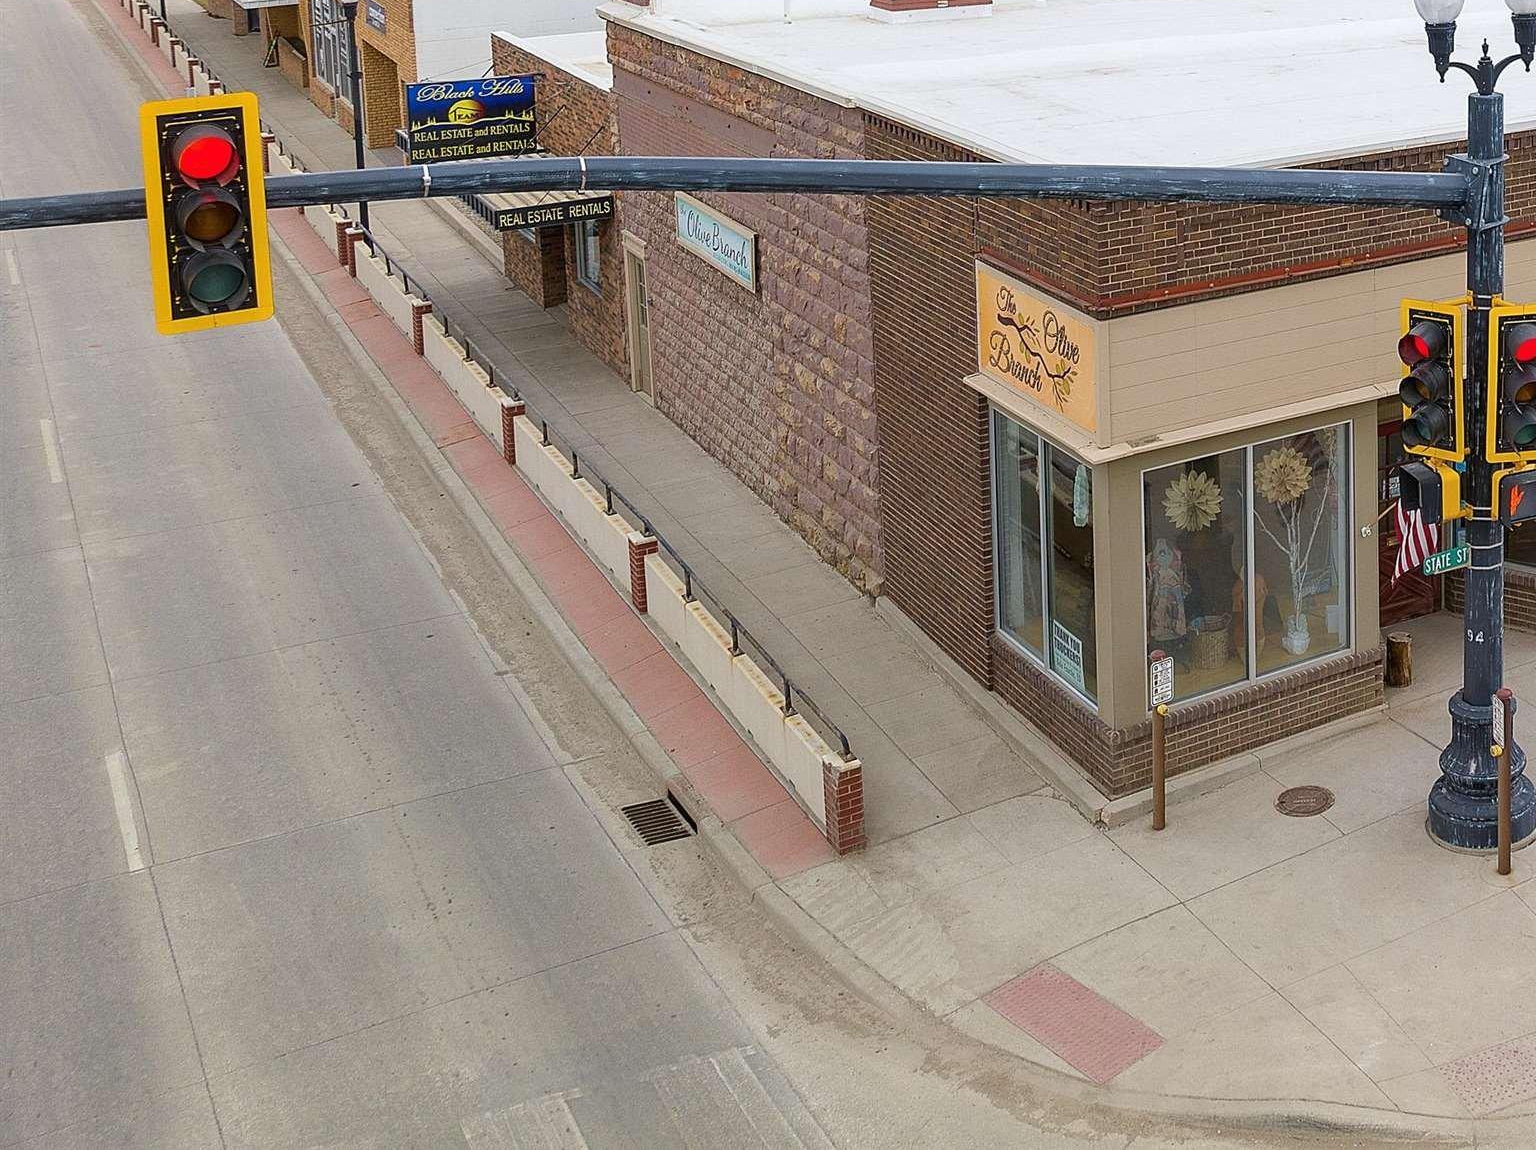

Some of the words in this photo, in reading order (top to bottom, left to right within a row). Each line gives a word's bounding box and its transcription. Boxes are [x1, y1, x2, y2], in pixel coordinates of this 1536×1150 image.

[416, 83, 475, 102] Black
[479, 78, 524, 97] Hills
[414, 131, 440, 143] REAL
[441, 128, 473, 140] ESTATE
[474, 127, 489, 137] and
[490, 122, 531, 136] RENTALS
[412, 147, 440, 161] REAL
[440, 144, 475, 158] ESTATE
[476, 143, 491, 154] and
[493, 138, 536, 152] RENTALS
[499, 212, 526, 227] REAL
[528, 207, 564, 223] ESTATE
[569, 201, 611, 218] RENTALS
[687, 210, 711, 248] Olive
[712, 222, 748, 269] Branch
[996, 285, 1017, 314] The
[1042, 310, 1080, 365] Olive
[989, 329, 1042, 392] Branch
[1425, 552, 1452, 573] STATE
[1456, 547, 1469, 564] ST
